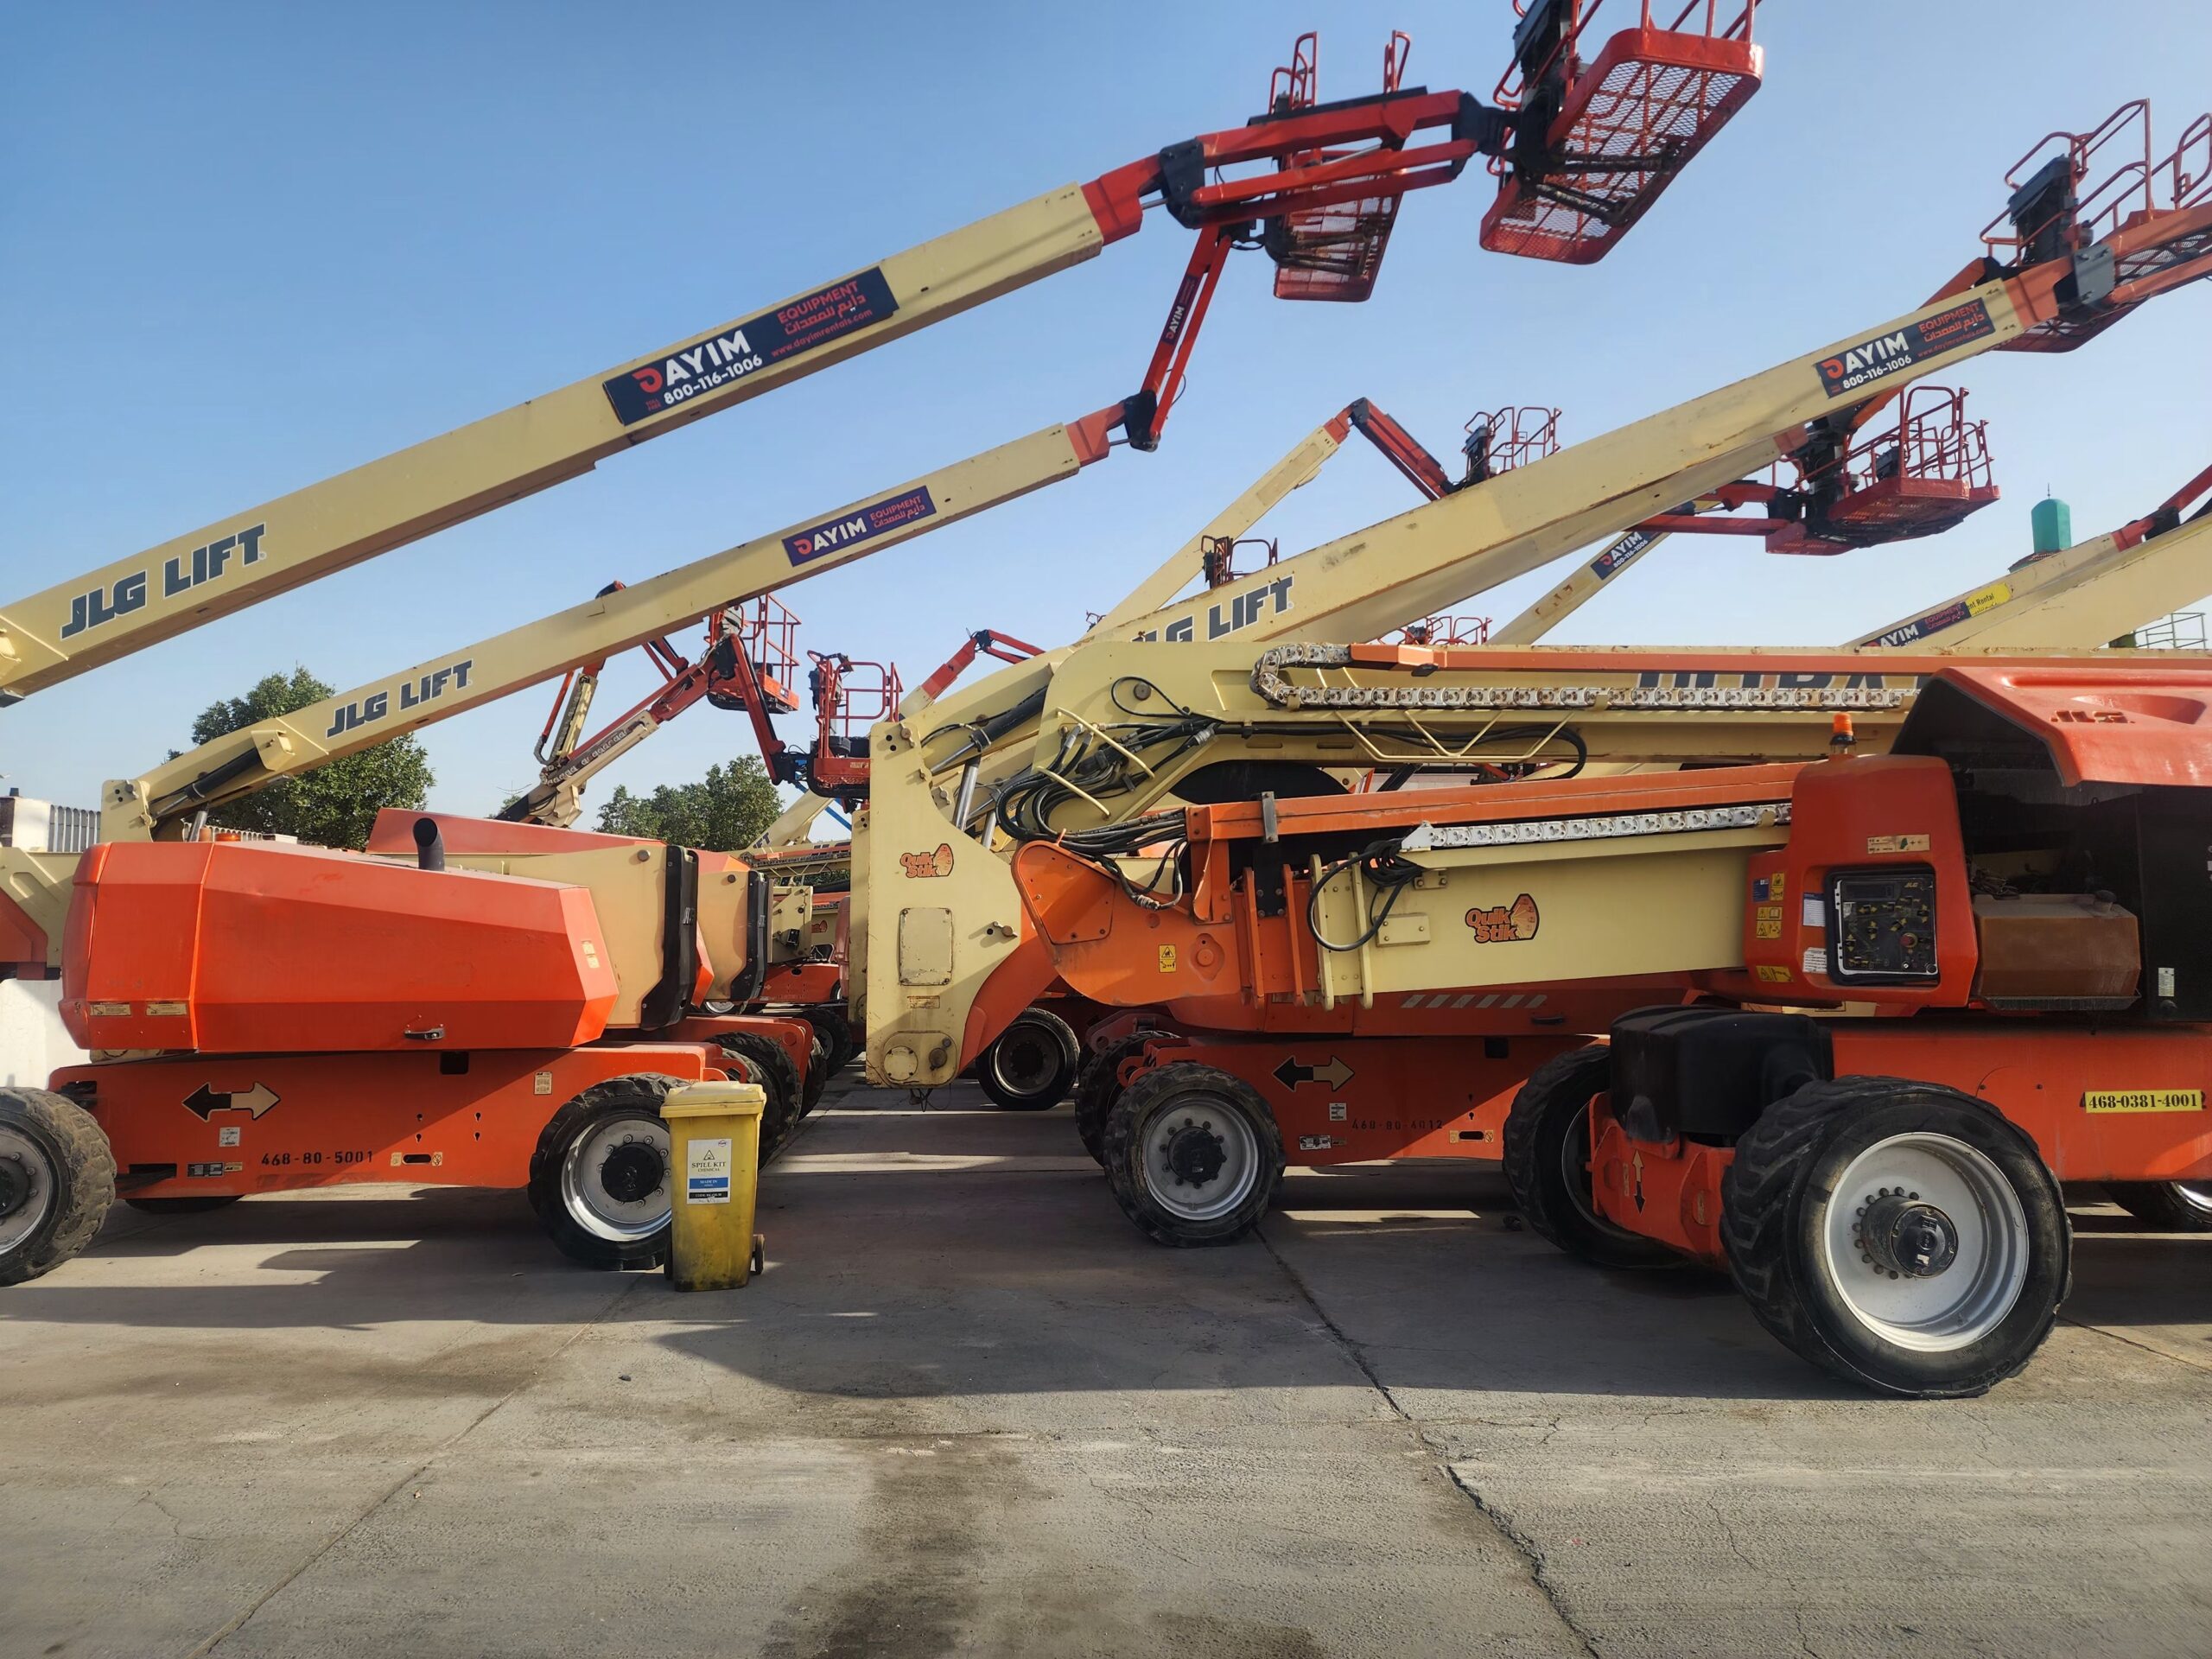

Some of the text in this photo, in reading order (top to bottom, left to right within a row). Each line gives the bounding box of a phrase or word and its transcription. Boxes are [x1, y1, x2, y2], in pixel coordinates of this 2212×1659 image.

[778, 281, 857, 323] EQUIPMENT
[1919, 302, 1980, 334] EQUIPMENT
[771, 309, 873, 358] www.dayimrentals.com
[1166, 305, 1185, 340] DAYIM
[632, 329, 752, 393] DAYIM
[1821, 332, 1910, 379] DAYIM
[1843, 355, 1912, 389] 800-116-1006
[664, 354, 763, 404] 800-116-1006
[869, 495, 921, 522] EQUIPMENT
[793, 518, 867, 555] DAYIM
[1599, 531, 1643, 566] DAYIM
[1613, 539, 1648, 569] 800-116-1006
[60, 522, 265, 640] JLG LIFT
[1208, 575, 1294, 642] LIFT
[1976, 592, 1995, 607] Rental
[326, 658, 473, 739] JLG LIFT
[2050, 711, 2128, 723] JLG
[900, 852, 933, 867] Quik
[906, 864, 938, 878] Stik
[1465, 907, 1511, 928] Quik
[1474, 924, 1517, 944] Stik
[2088, 1093, 2197, 1109] 468-0381-4001
